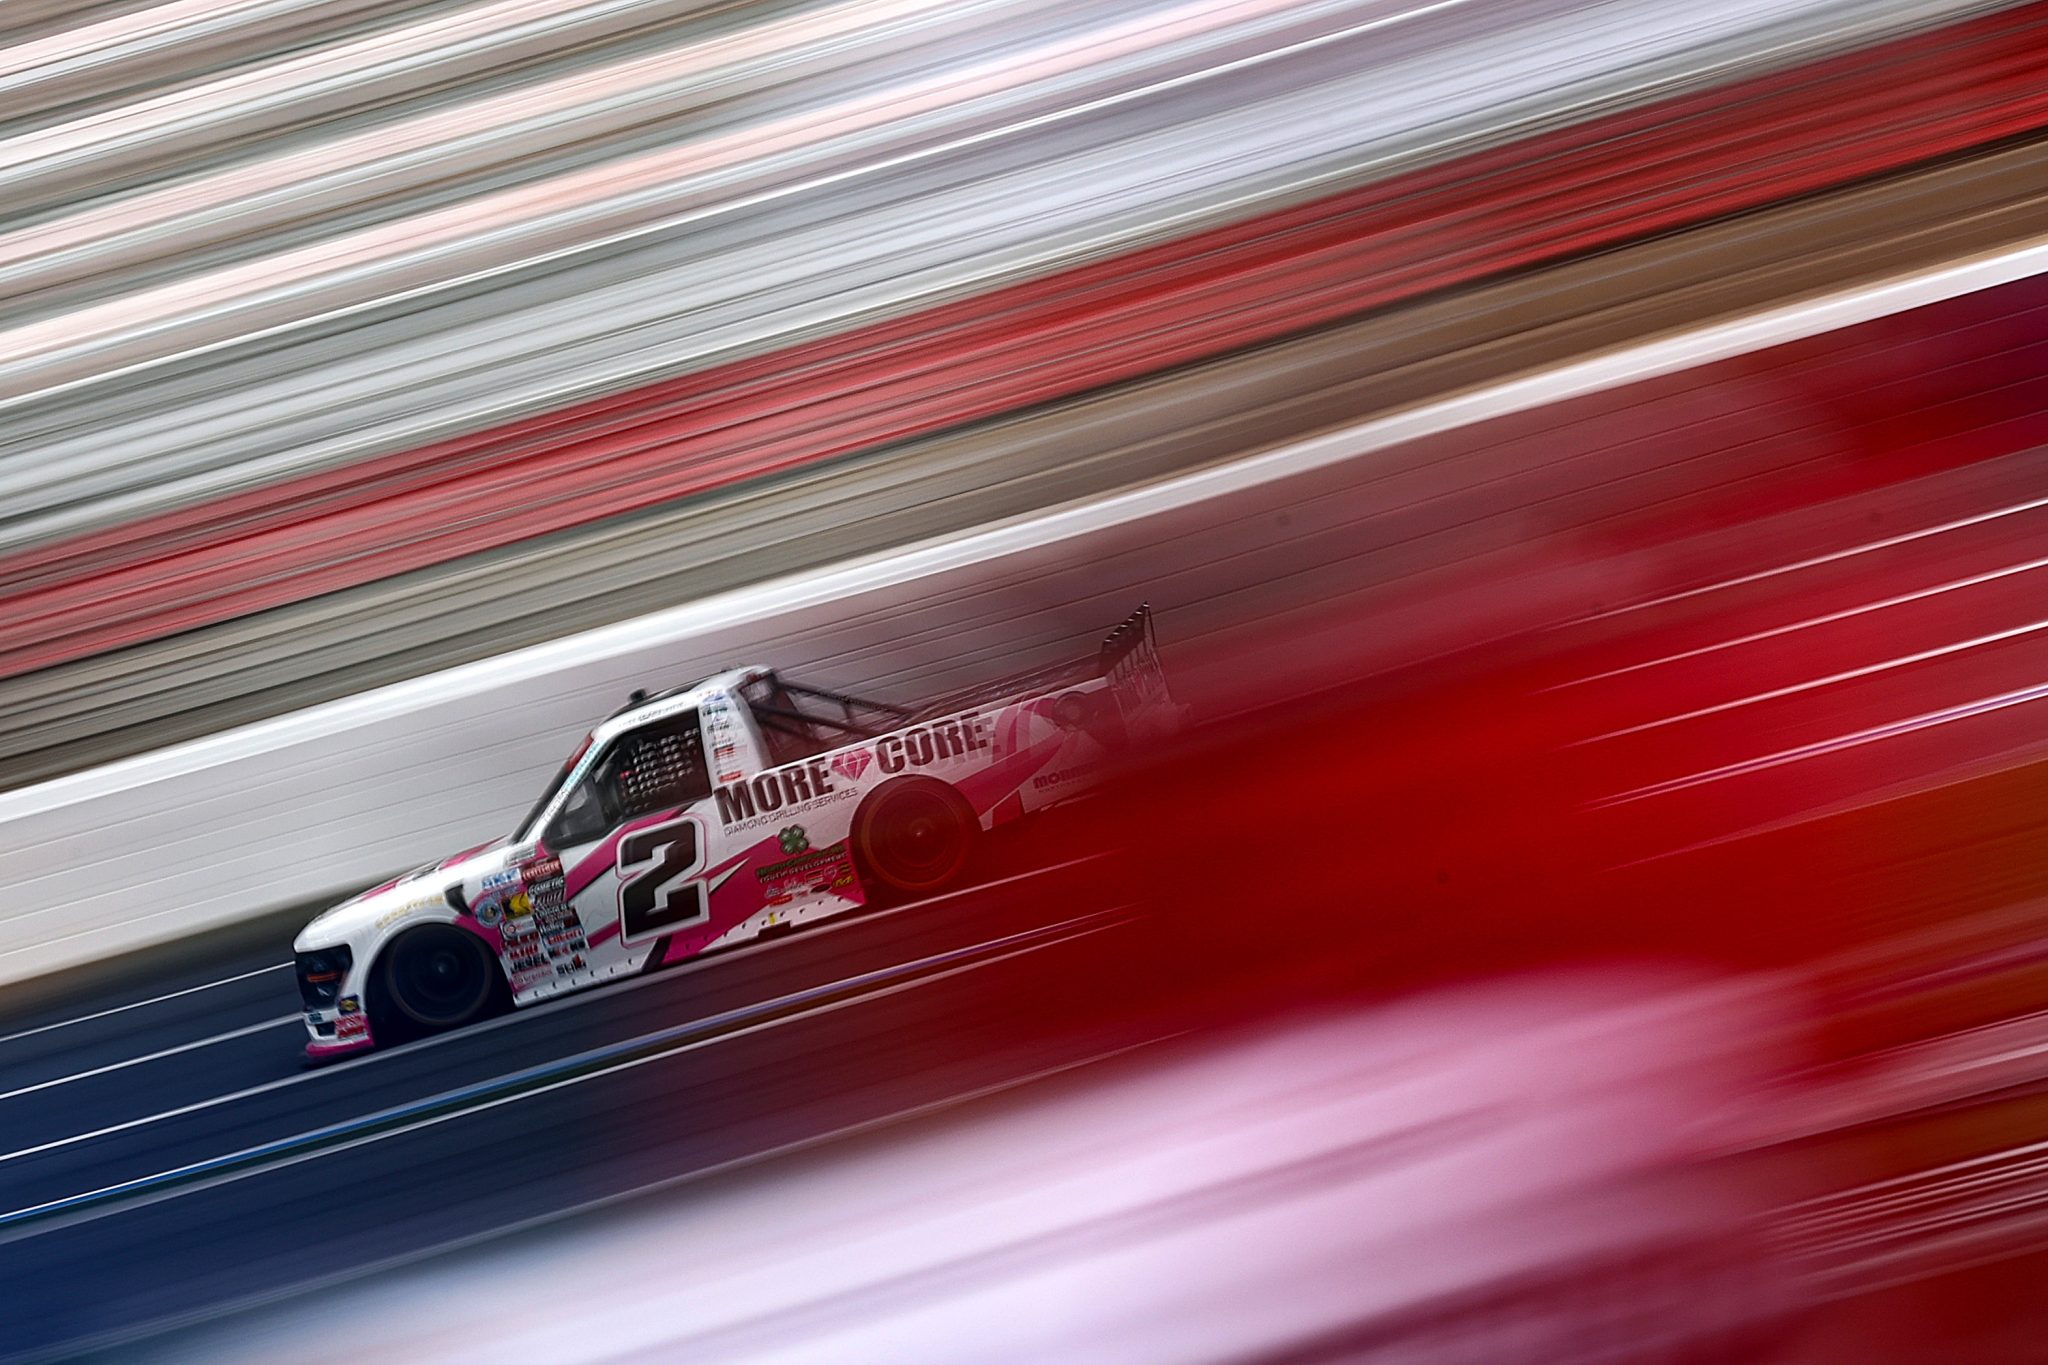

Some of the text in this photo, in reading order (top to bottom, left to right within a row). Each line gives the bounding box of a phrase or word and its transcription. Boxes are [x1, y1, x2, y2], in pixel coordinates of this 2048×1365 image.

[712, 711, 989, 826] MORE CORE
[811, 787, 859, 811] SERVICES
[619, 818, 706, 942] 2
